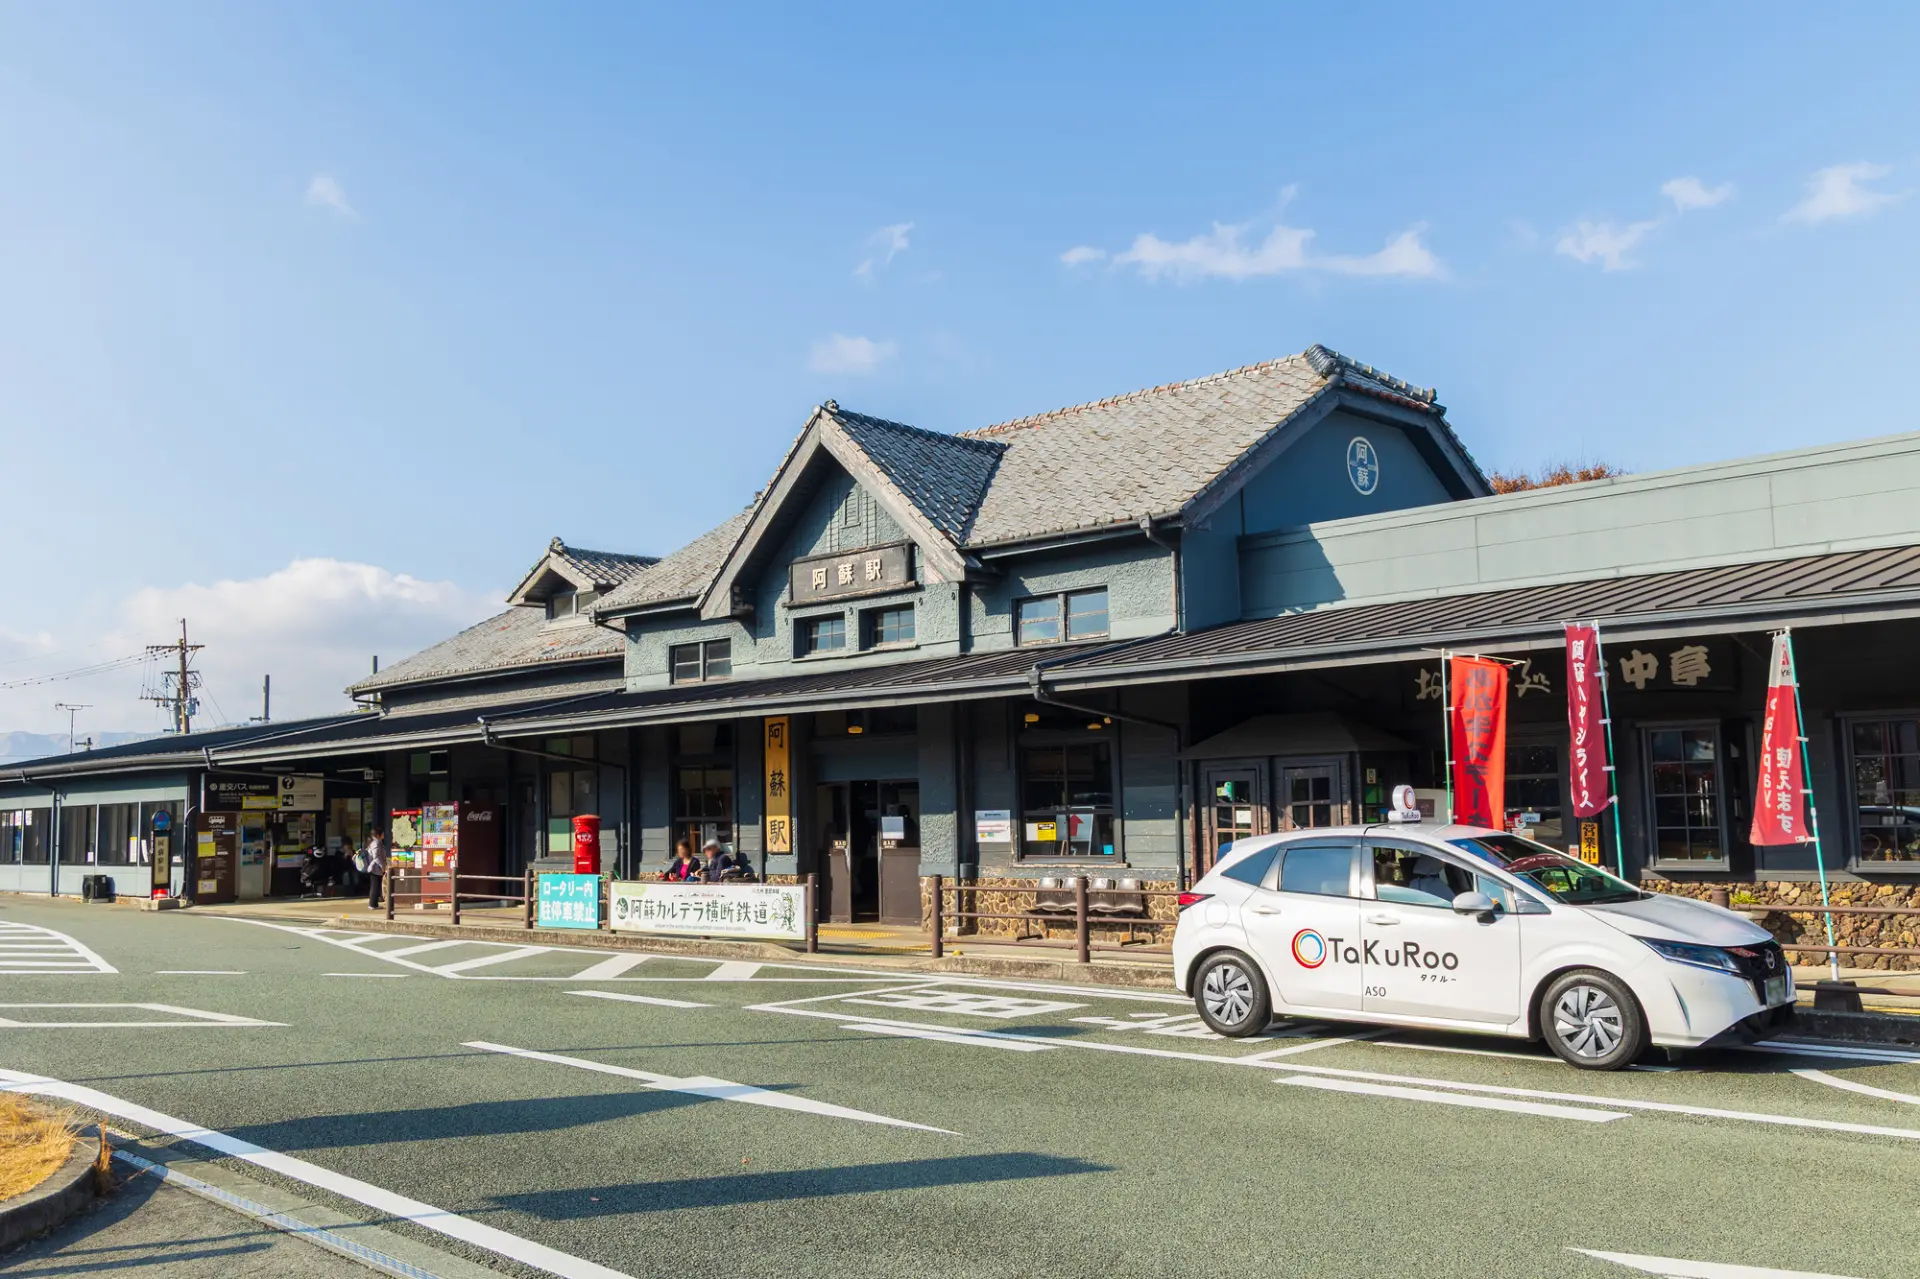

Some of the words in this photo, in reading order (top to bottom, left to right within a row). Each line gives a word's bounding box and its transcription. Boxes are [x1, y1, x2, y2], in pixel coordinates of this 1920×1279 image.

[812, 558, 883, 590] 阿蘇駅
[1600, 646, 1711, 690] 中亭
[767, 721, 787, 845] 阿蘇駅
[1583, 823, 1597, 862] 営業中
[542, 879, 593, 898] ロータリー内
[541, 901, 596, 923] 駐停車禁止
[630, 898, 769, 925] 阿蘇カルデラ横断鉄道
[1328, 937, 1459, 971] TaKuRoo
[1365, 985, 1387, 998] ASO
[1420, 974, 1457, 983] タクルー
